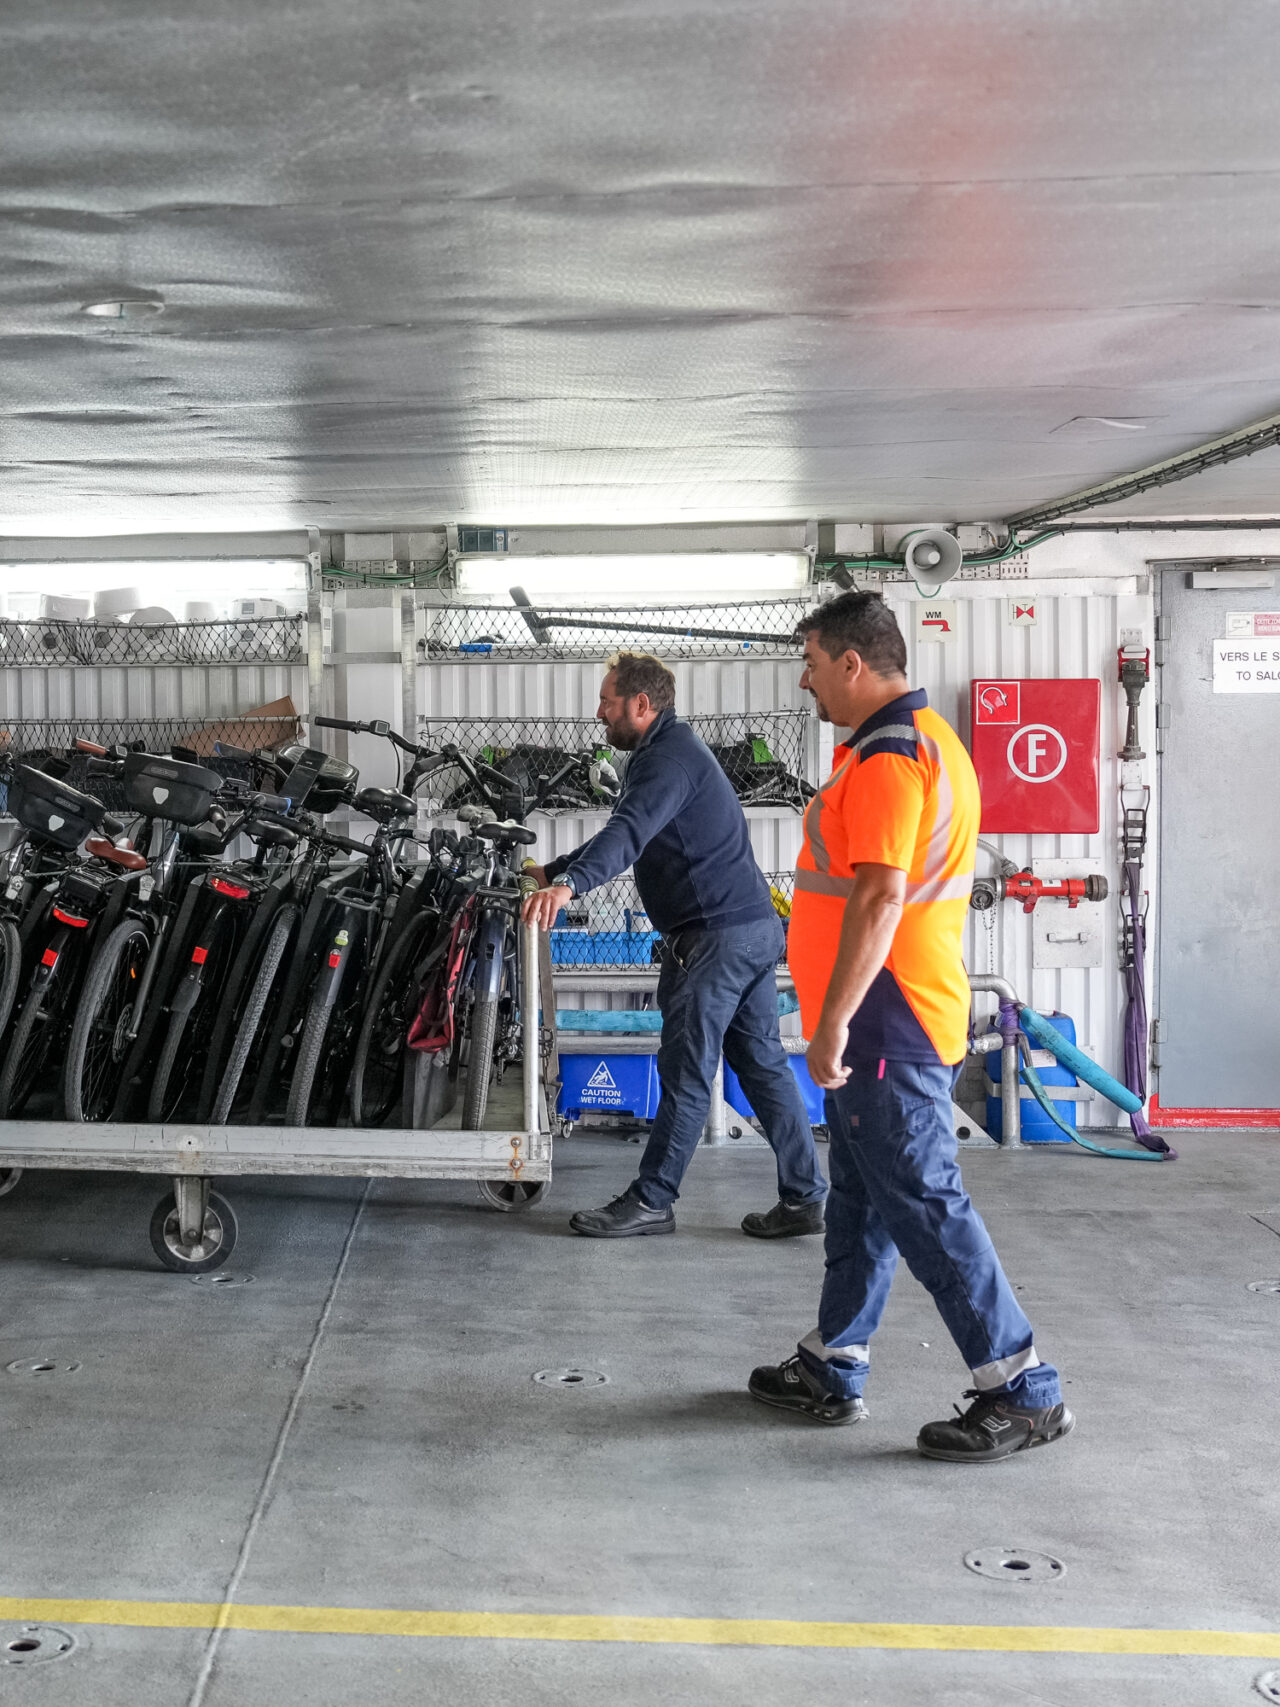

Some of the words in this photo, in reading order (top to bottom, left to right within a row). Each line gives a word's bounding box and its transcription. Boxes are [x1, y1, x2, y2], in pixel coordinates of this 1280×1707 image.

[925, 611, 942, 619] WM
[1220, 652, 1249, 661] VERS
[1254, 652, 1267, 661] LE
[1236, 671, 1251, 681] TO
[1028, 733, 1047, 774] F
[581, 1089, 621, 1097] CAUTION
